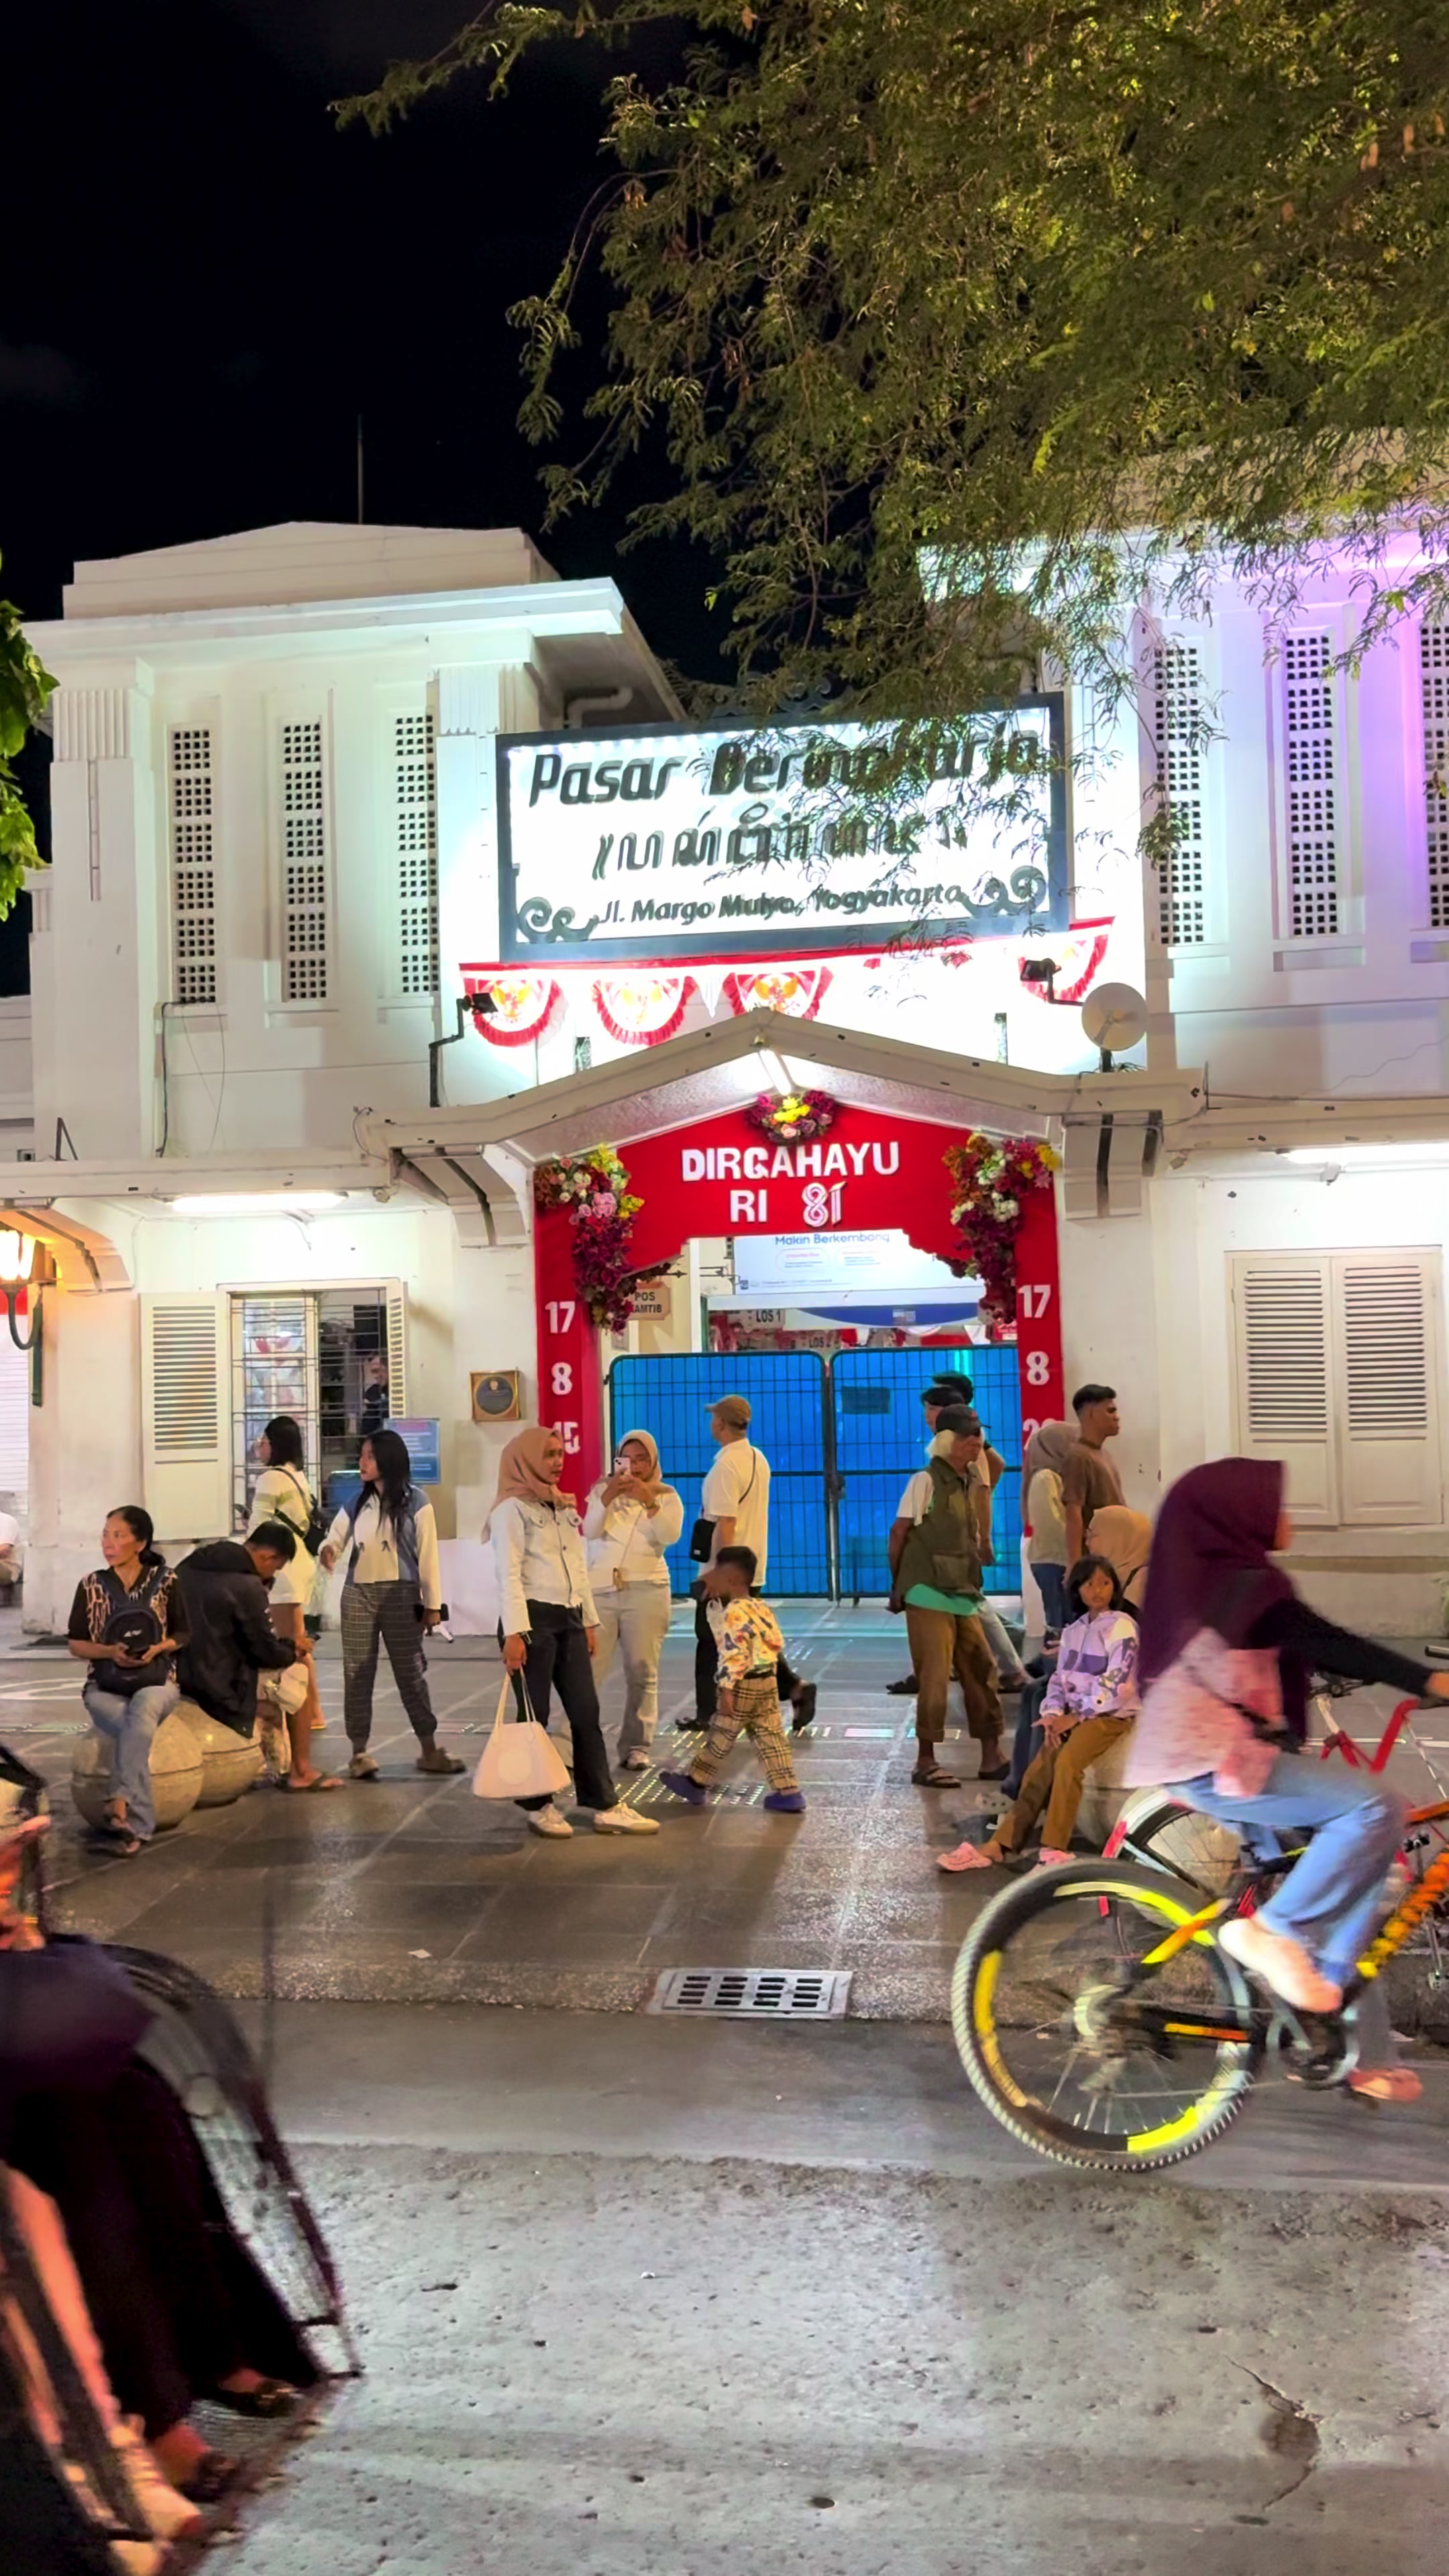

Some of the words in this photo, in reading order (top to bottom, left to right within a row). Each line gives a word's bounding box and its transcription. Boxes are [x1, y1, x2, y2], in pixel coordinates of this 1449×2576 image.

[529, 753, 687, 808] Pasar
[601, 900, 625, 924] Jl.
[631, 898, 715, 926] Margo
[814, 883, 962, 915] Yogyakarta
[682, 1142, 900, 1182] DIRGAHAYU
[730, 1189, 767, 1223] RI
[802, 1181, 847, 1228] 81
[775, 1234, 810, 1246] Makin
[814, 1232, 890, 1244] Berkembang
[633, 1304, 663, 1313] AMTIB
[635, 1291, 655, 1301] POS
[1018, 1284, 1052, 1319] 17
[545, 1300, 576, 1334] 17
[756, 1309, 773, 1322] LOS
[551, 1362, 574, 1396] 8
[1026, 1350, 1051, 1386] 8
[1023, 1417, 1057, 1451] 2
